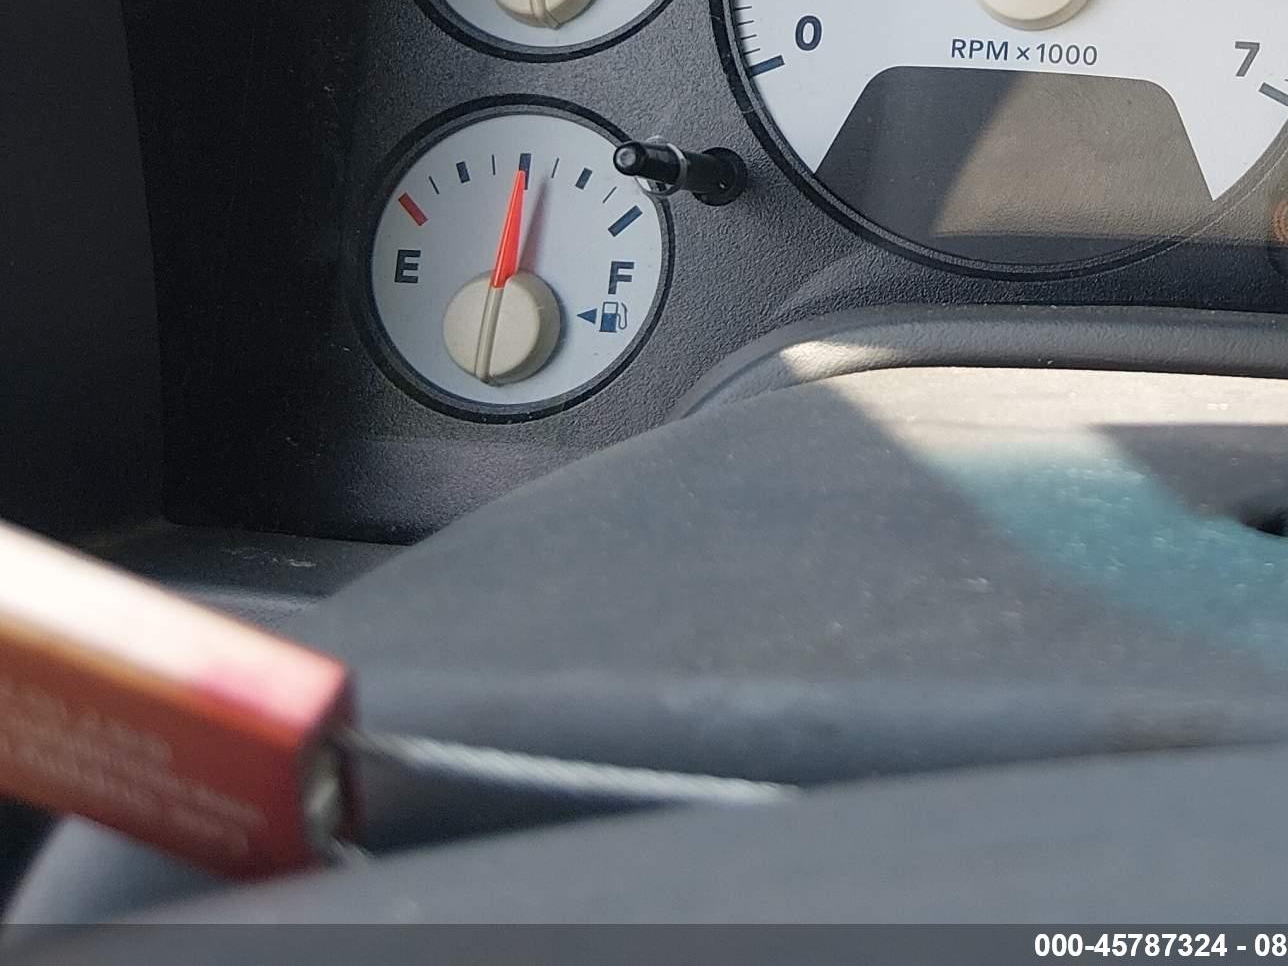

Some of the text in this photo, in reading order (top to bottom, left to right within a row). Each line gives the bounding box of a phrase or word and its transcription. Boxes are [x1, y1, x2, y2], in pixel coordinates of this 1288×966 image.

[794, 15, 823, 52] 0
[951, 38, 1009, 61] RPM
[1234, 40, 1261, 78] 7
[393, 249, 422, 284] E
[607, 260, 635, 295] F
